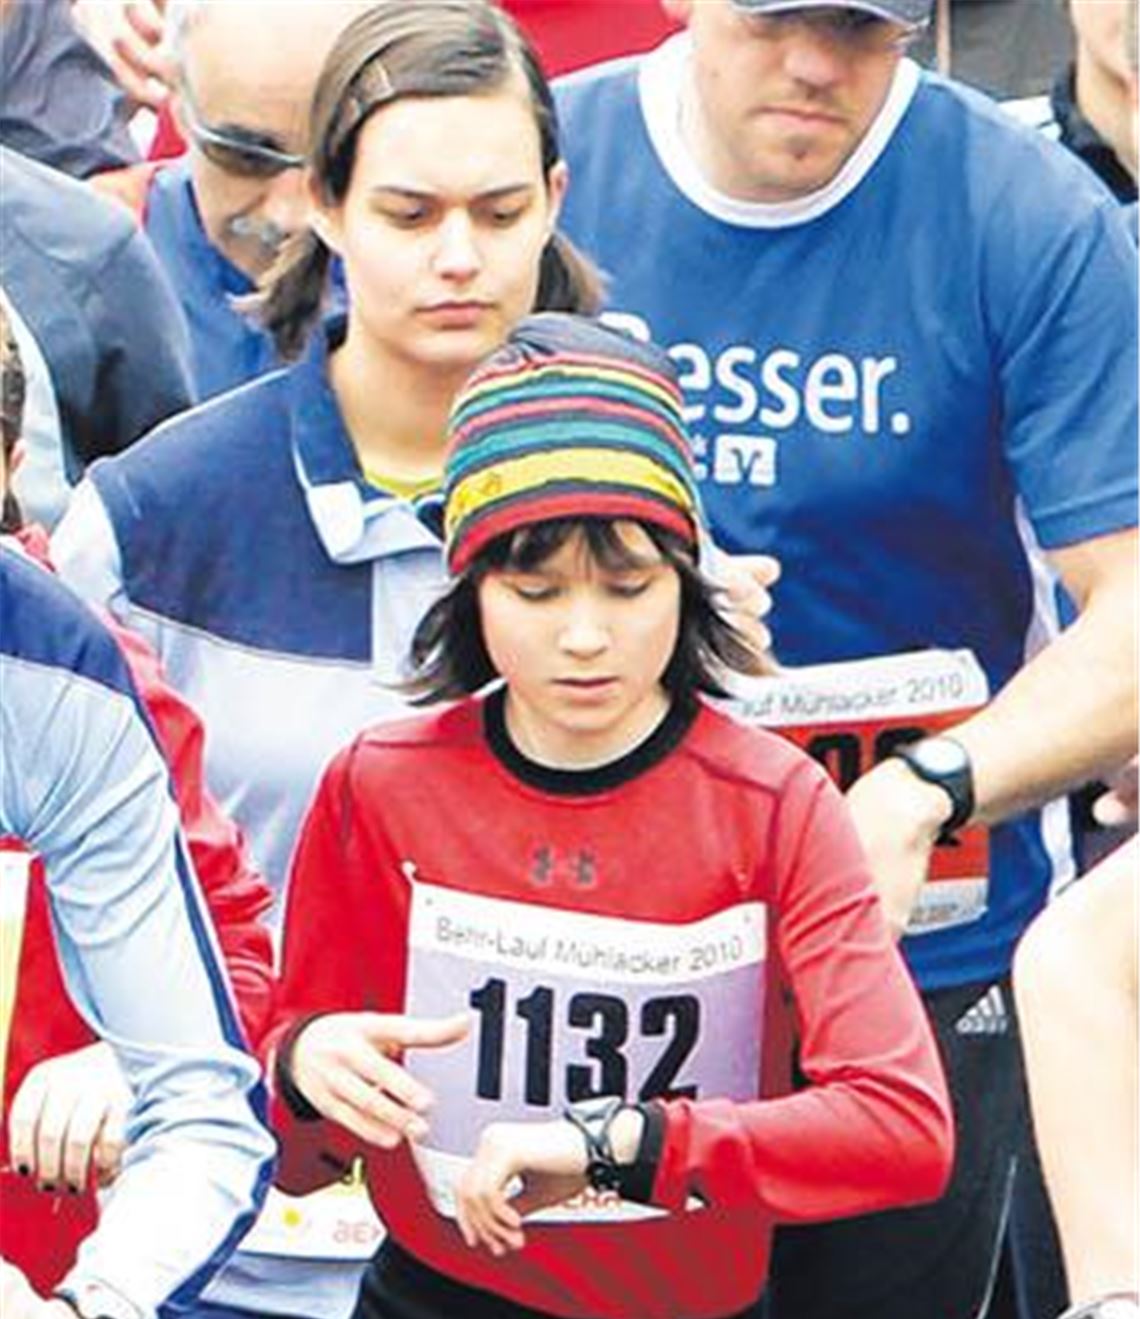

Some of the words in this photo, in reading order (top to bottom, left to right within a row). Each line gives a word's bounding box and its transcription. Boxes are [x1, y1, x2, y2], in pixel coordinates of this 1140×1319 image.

[906, 672, 964, 703] 2010
[688, 936, 743, 971] 2010
[469, 977, 701, 1107] 1132
